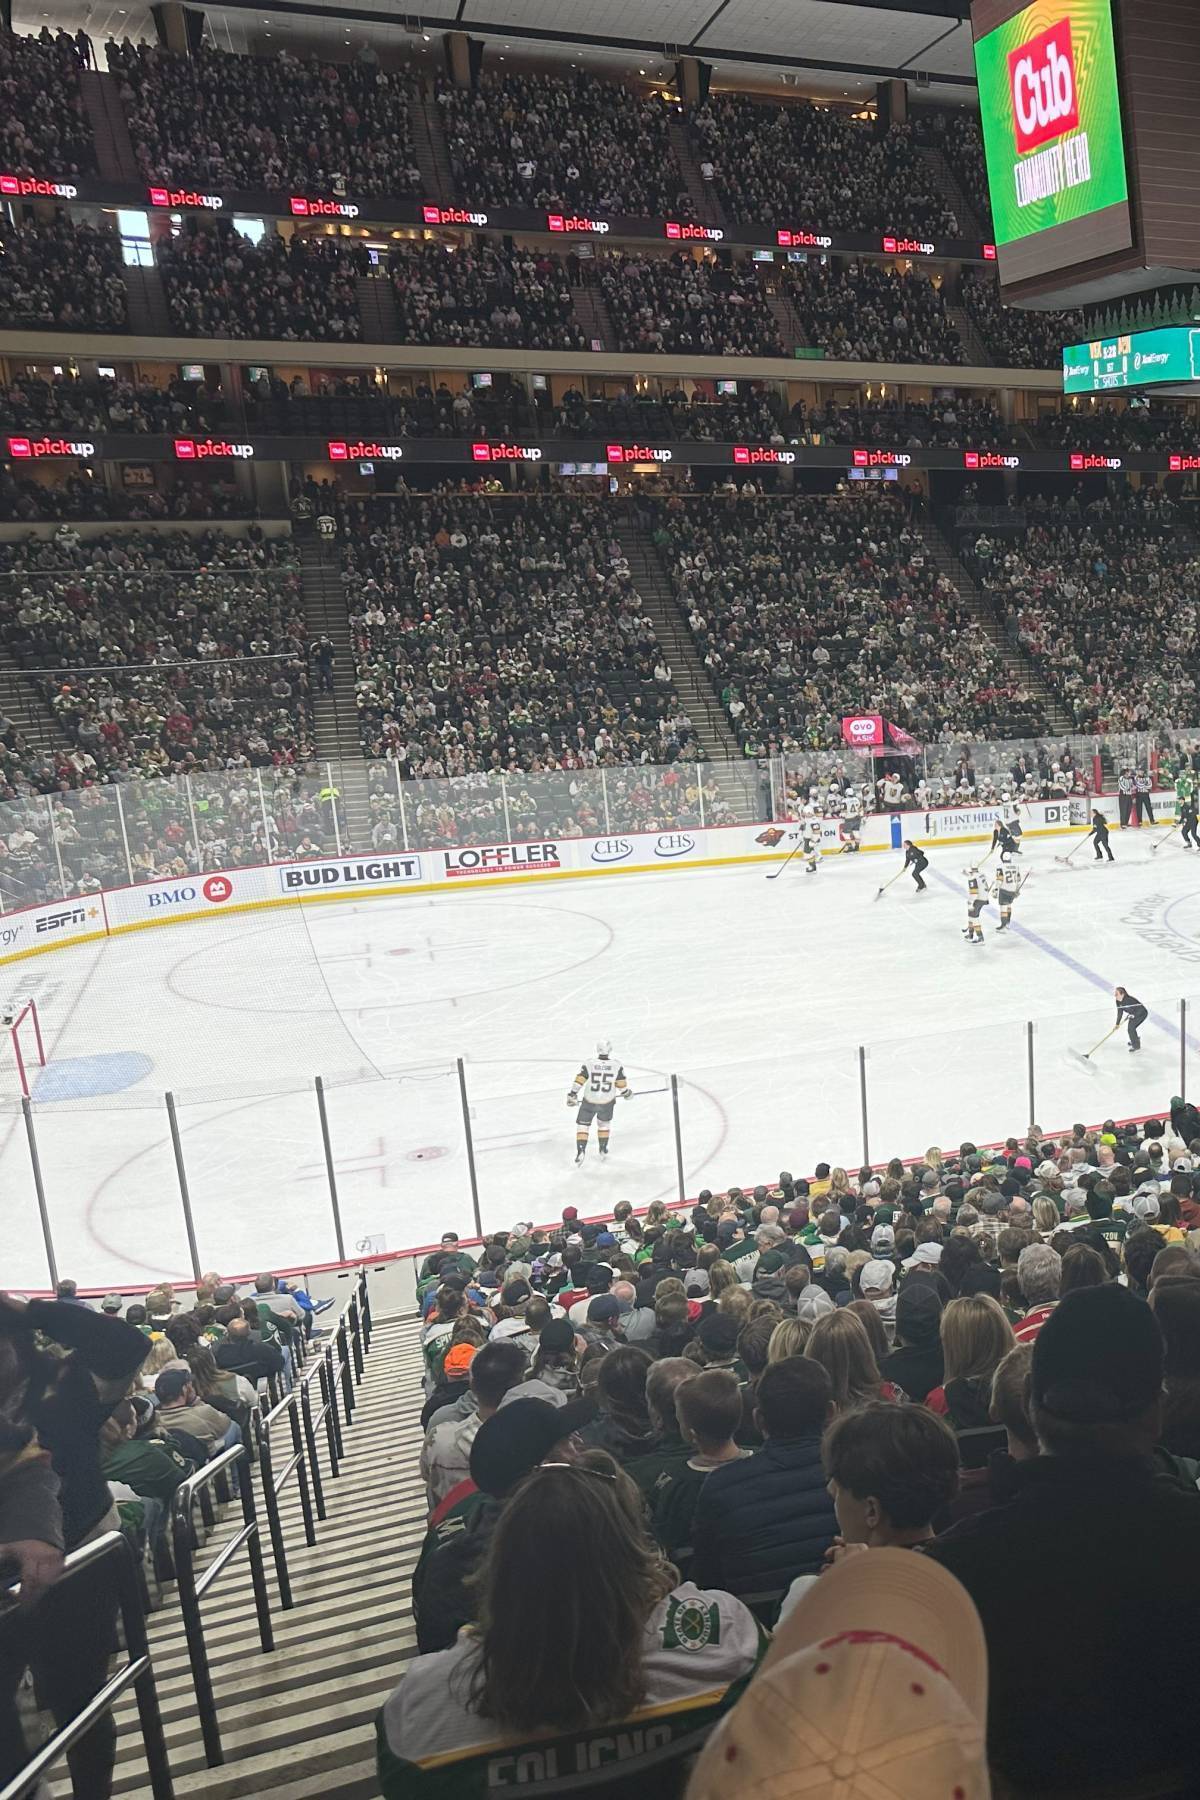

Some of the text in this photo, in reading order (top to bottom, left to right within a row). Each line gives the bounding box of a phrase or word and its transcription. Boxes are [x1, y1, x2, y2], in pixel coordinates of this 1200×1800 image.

[1014, 41, 1073, 135] Cub
[1014, 131, 1091, 208] COMMUNITY HERO
[20, 178, 77, 199] pickup
[170, 190, 223, 209] pickup
[309, 199, 359, 218] pickup
[441, 208, 488, 227] pickup
[565, 216, 609, 234] pickup
[681, 224, 723, 241] pickup
[792, 231, 832, 248] pickup
[897, 238, 935, 255] pickup
[33, 437, 94, 457] pickup
[196, 439, 254, 458] pickup
[349, 441, 402, 460] pickup
[491, 443, 542, 460] pickup
[624, 445, 672, 463] pickup
[750, 447, 795, 464] pickup
[869, 450, 911, 466] pickup
[980, 452, 1019, 469] pickup
[1084, 454, 1121, 470] pickup
[944, 814, 971, 826] FLINT
[973, 811, 1000, 823] HILLS
[594, 840, 630, 856] CHS
[657, 835, 692, 850] CHS
[444, 843, 560, 870] LOFFLER
[286, 861, 415, 887] BUD LIGHT
[147, 886, 197, 908] BMO
[590, 1072, 614, 1093] 55
